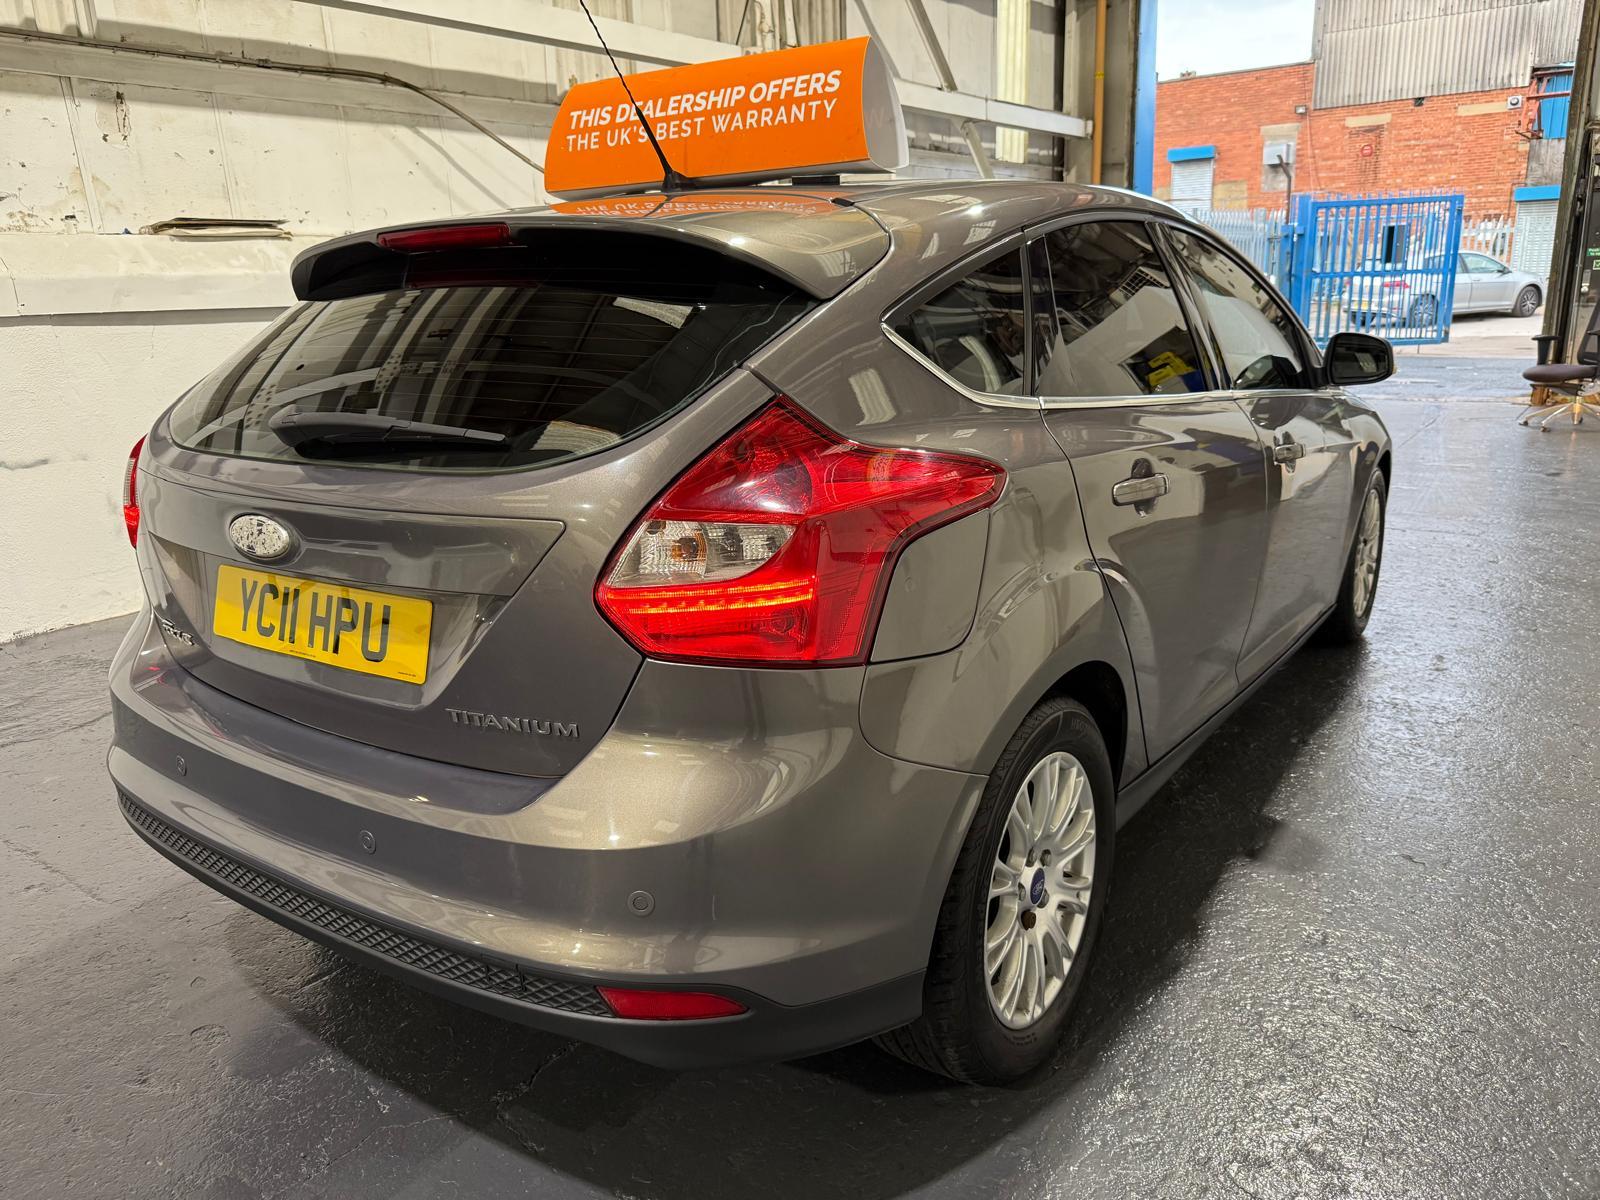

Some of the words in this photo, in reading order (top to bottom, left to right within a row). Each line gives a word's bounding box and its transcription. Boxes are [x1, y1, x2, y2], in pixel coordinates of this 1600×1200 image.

[566, 131, 600, 152] THE
[606, 124, 649, 147] UK'S
[656, 117, 706, 141] BEST
[711, 98, 838, 133] WARRANTY
[569, 105, 612, 130] THIS
[615, 85, 746, 123] DEALERSHIP
[749, 70, 842, 99] OFFERS
[241, 577, 300, 645] YC11
[307, 592, 391, 663] HPU
[445, 708, 580, 738] TITANIUM
